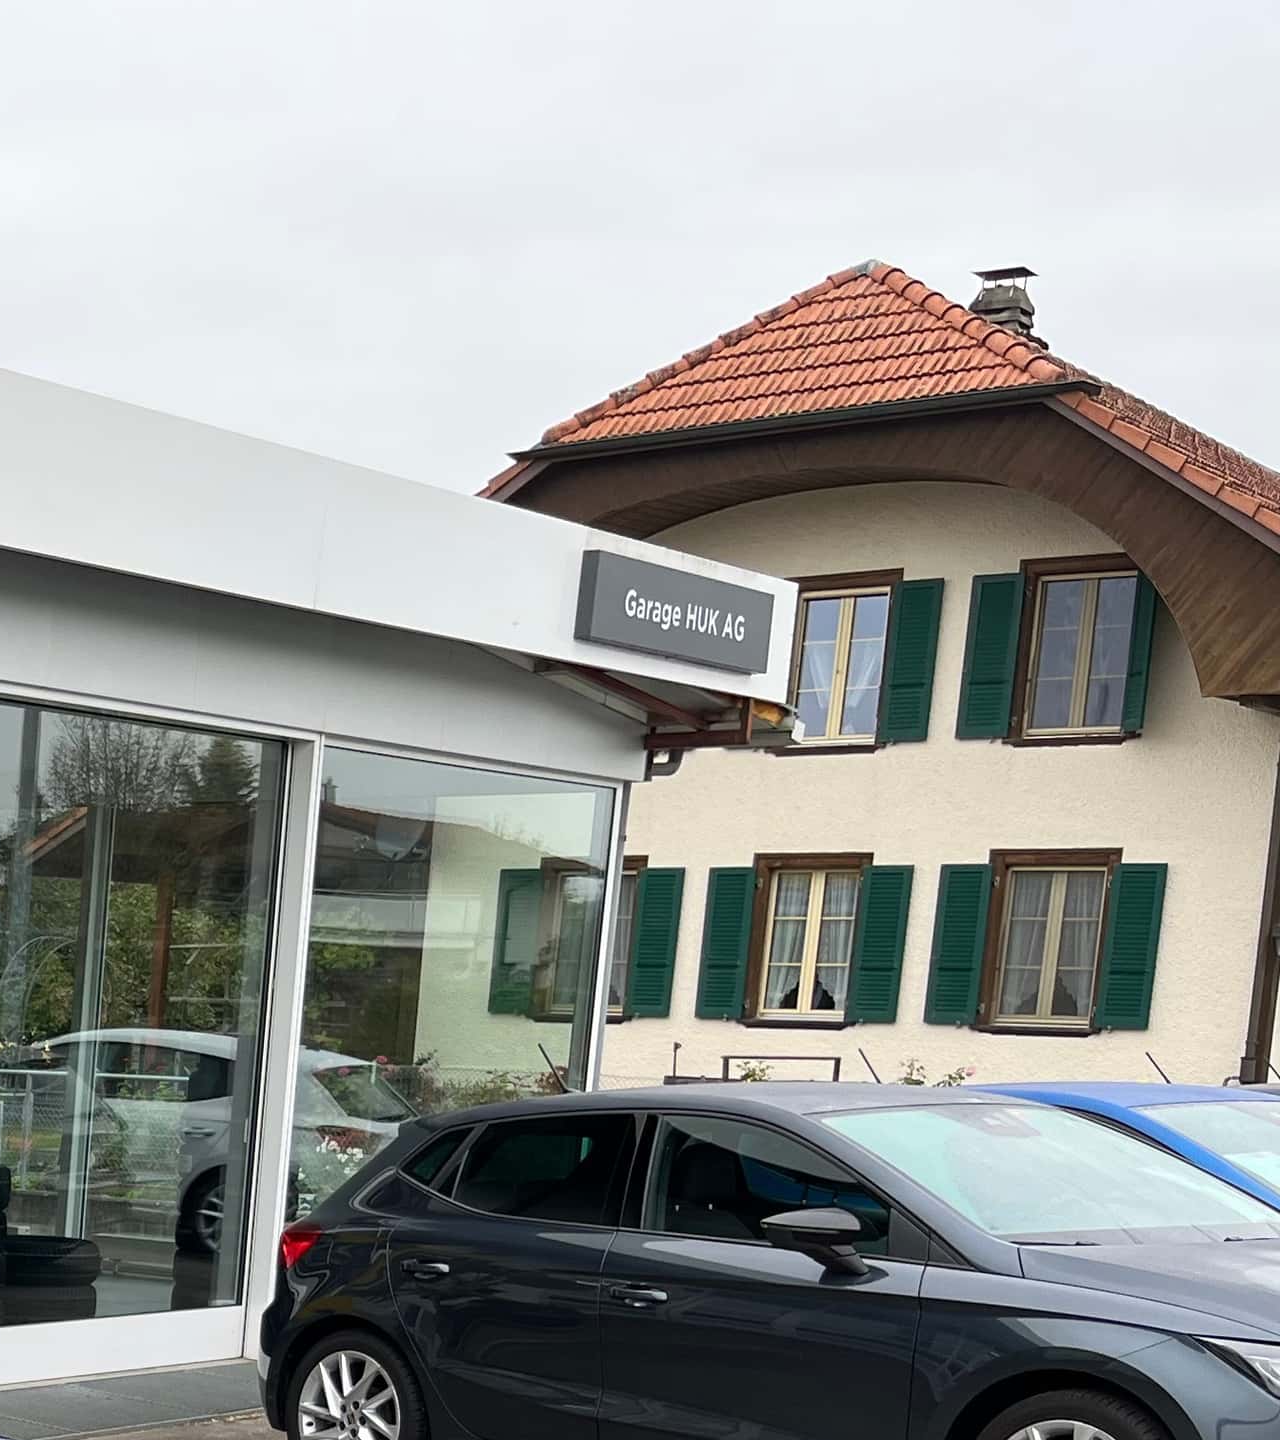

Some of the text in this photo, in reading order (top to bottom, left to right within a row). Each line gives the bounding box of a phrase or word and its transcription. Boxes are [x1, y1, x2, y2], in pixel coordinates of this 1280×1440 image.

[624, 588, 745, 642] Garage HUK AG
